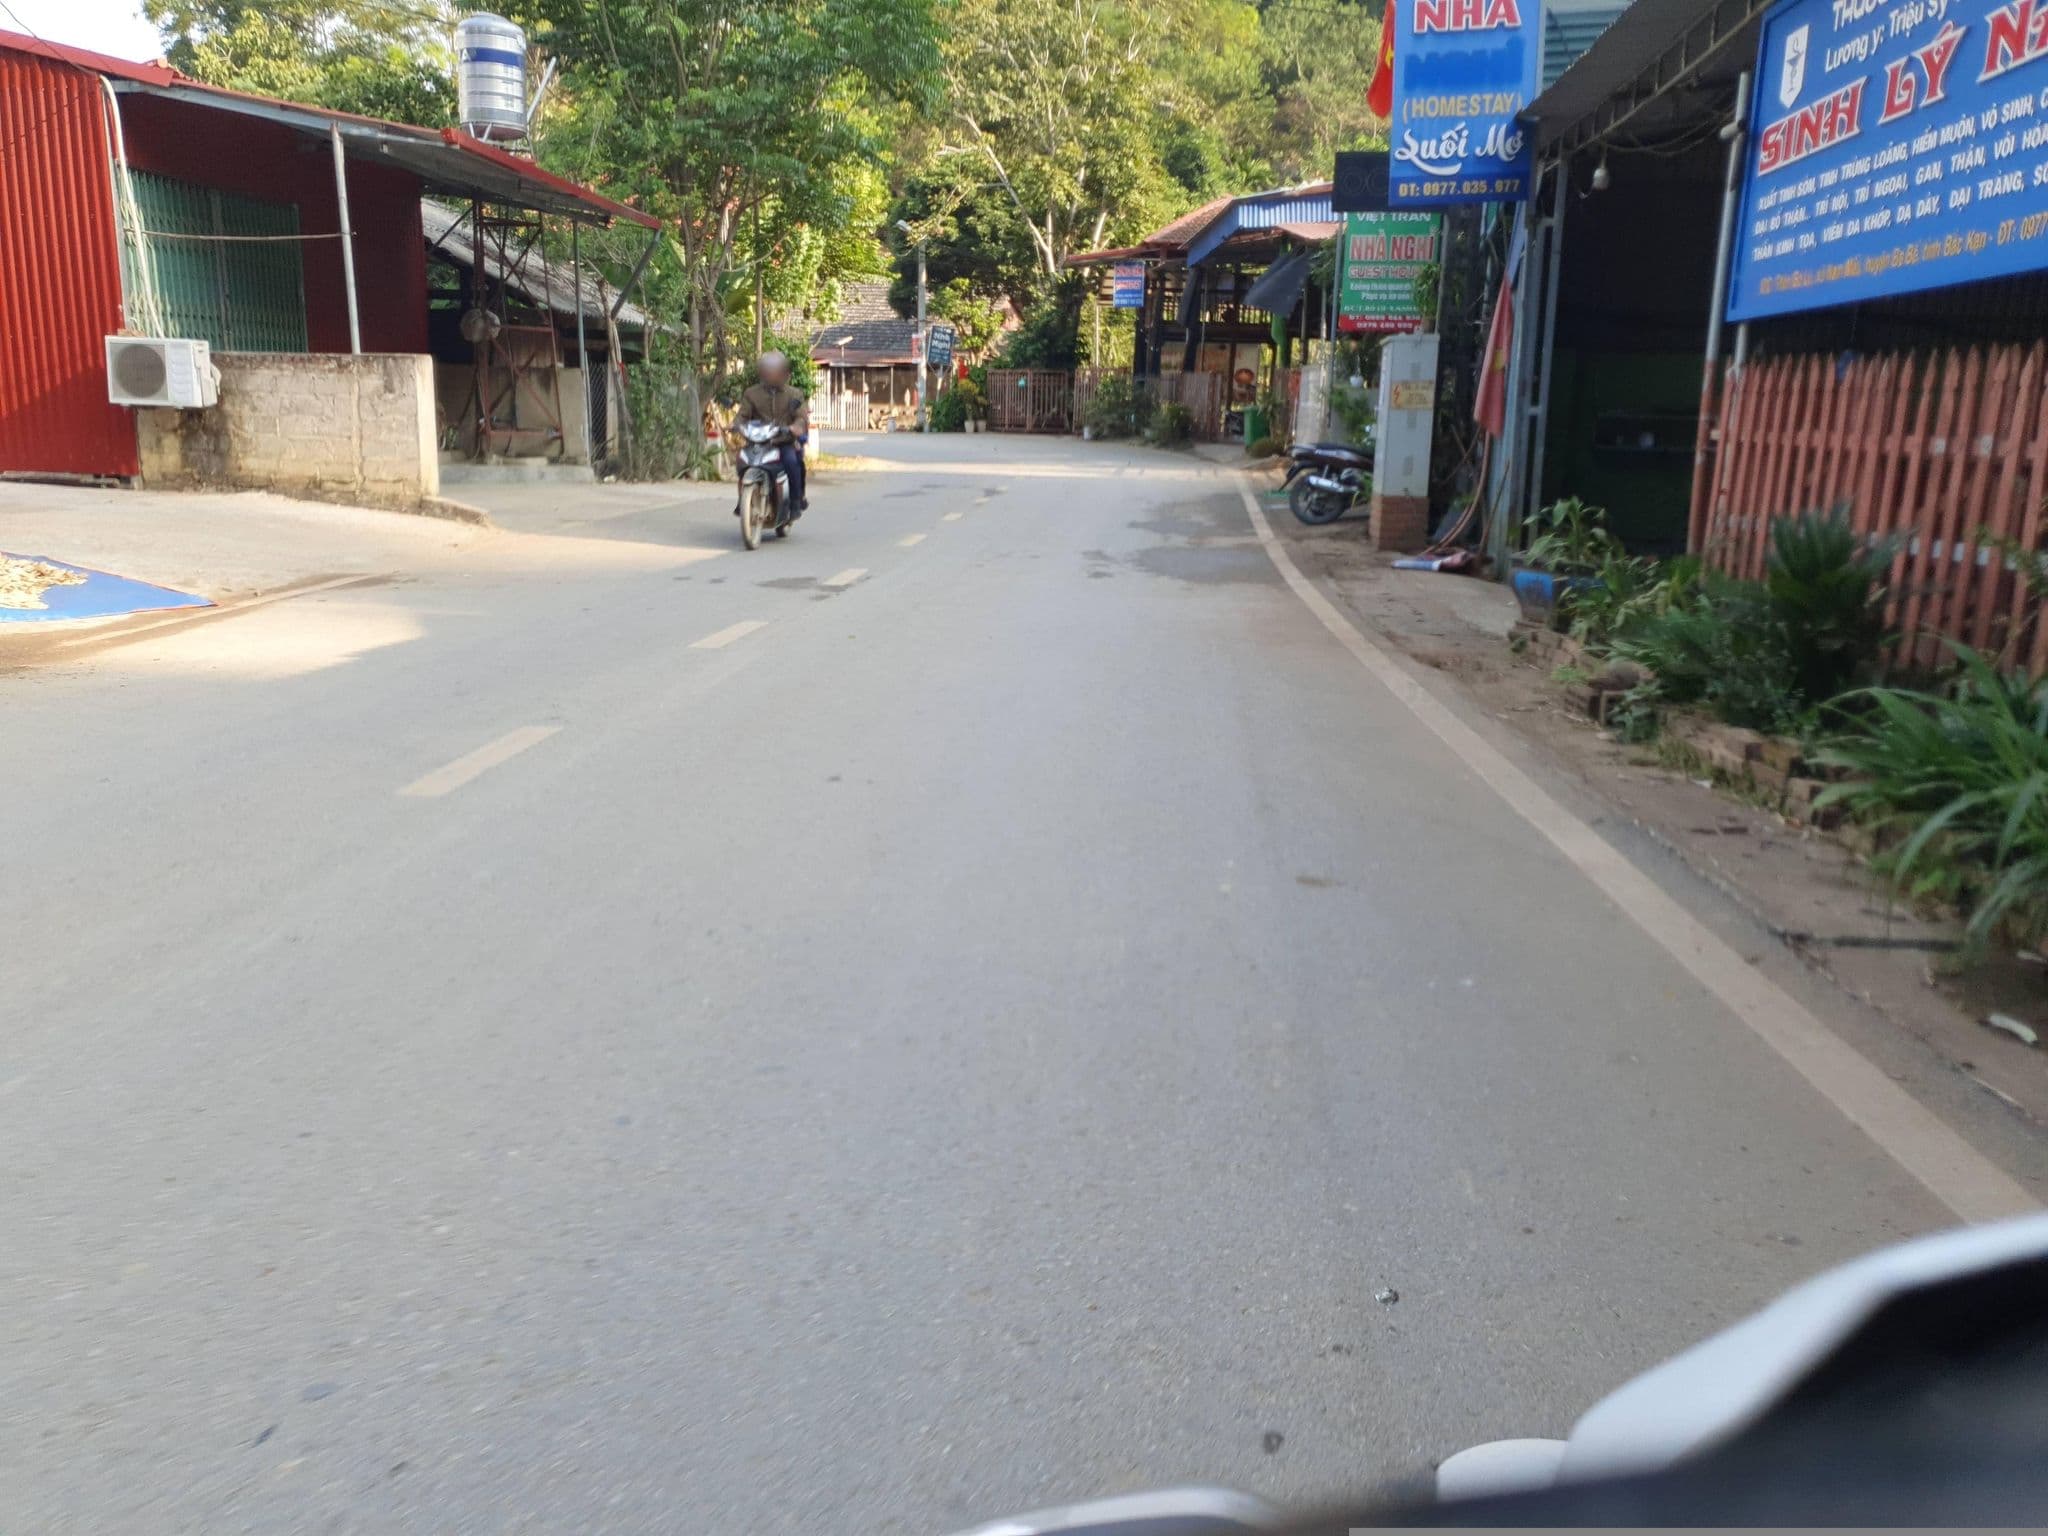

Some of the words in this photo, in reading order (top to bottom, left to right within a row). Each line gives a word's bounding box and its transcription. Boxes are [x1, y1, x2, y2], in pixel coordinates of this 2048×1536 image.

[1757, 76, 1868, 176] SINH
[1877, 20, 1967, 125] LÝ
[1394, 121, 1468, 176] Suối
[1349, 229, 1387, 261] NHÀ
